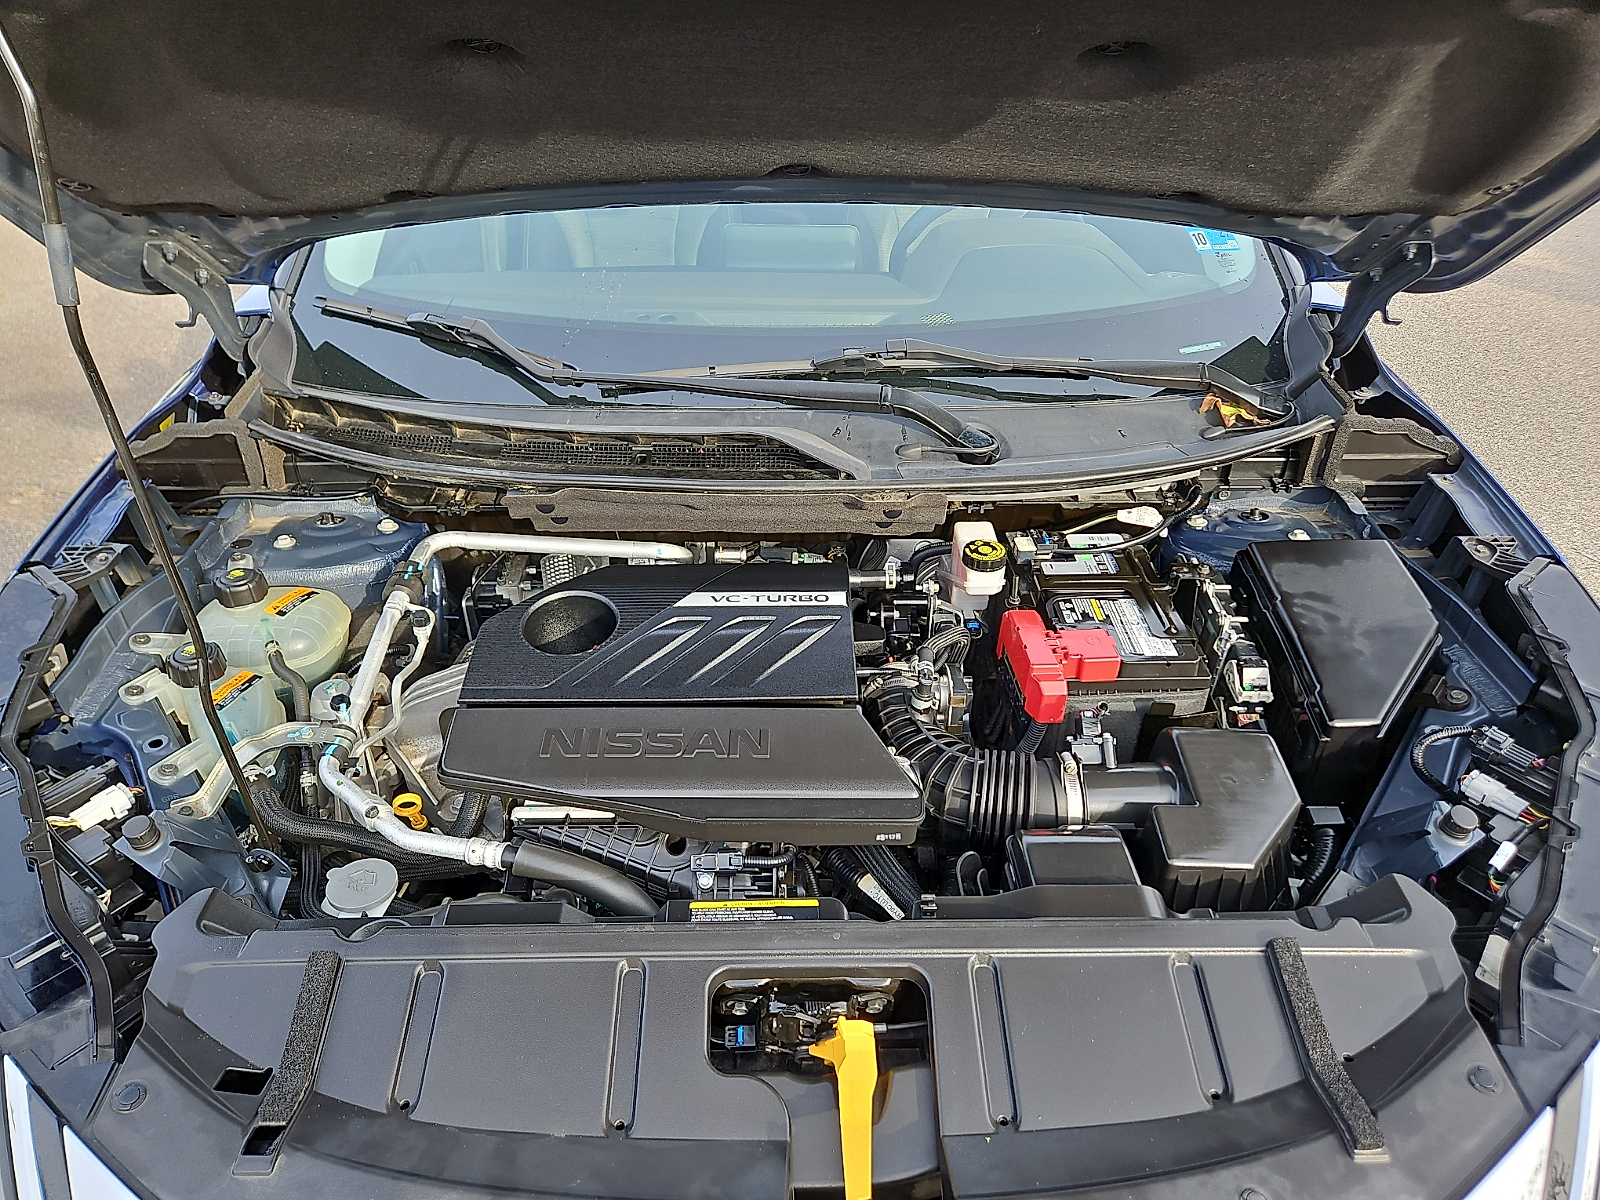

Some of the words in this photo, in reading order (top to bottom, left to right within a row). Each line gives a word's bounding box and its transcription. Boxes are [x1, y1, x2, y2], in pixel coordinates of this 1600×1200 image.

[1191, 232, 1208, 246] 10
[710, 594, 830, 604] VC-TURBO
[539, 728, 771, 759] NISSAN
